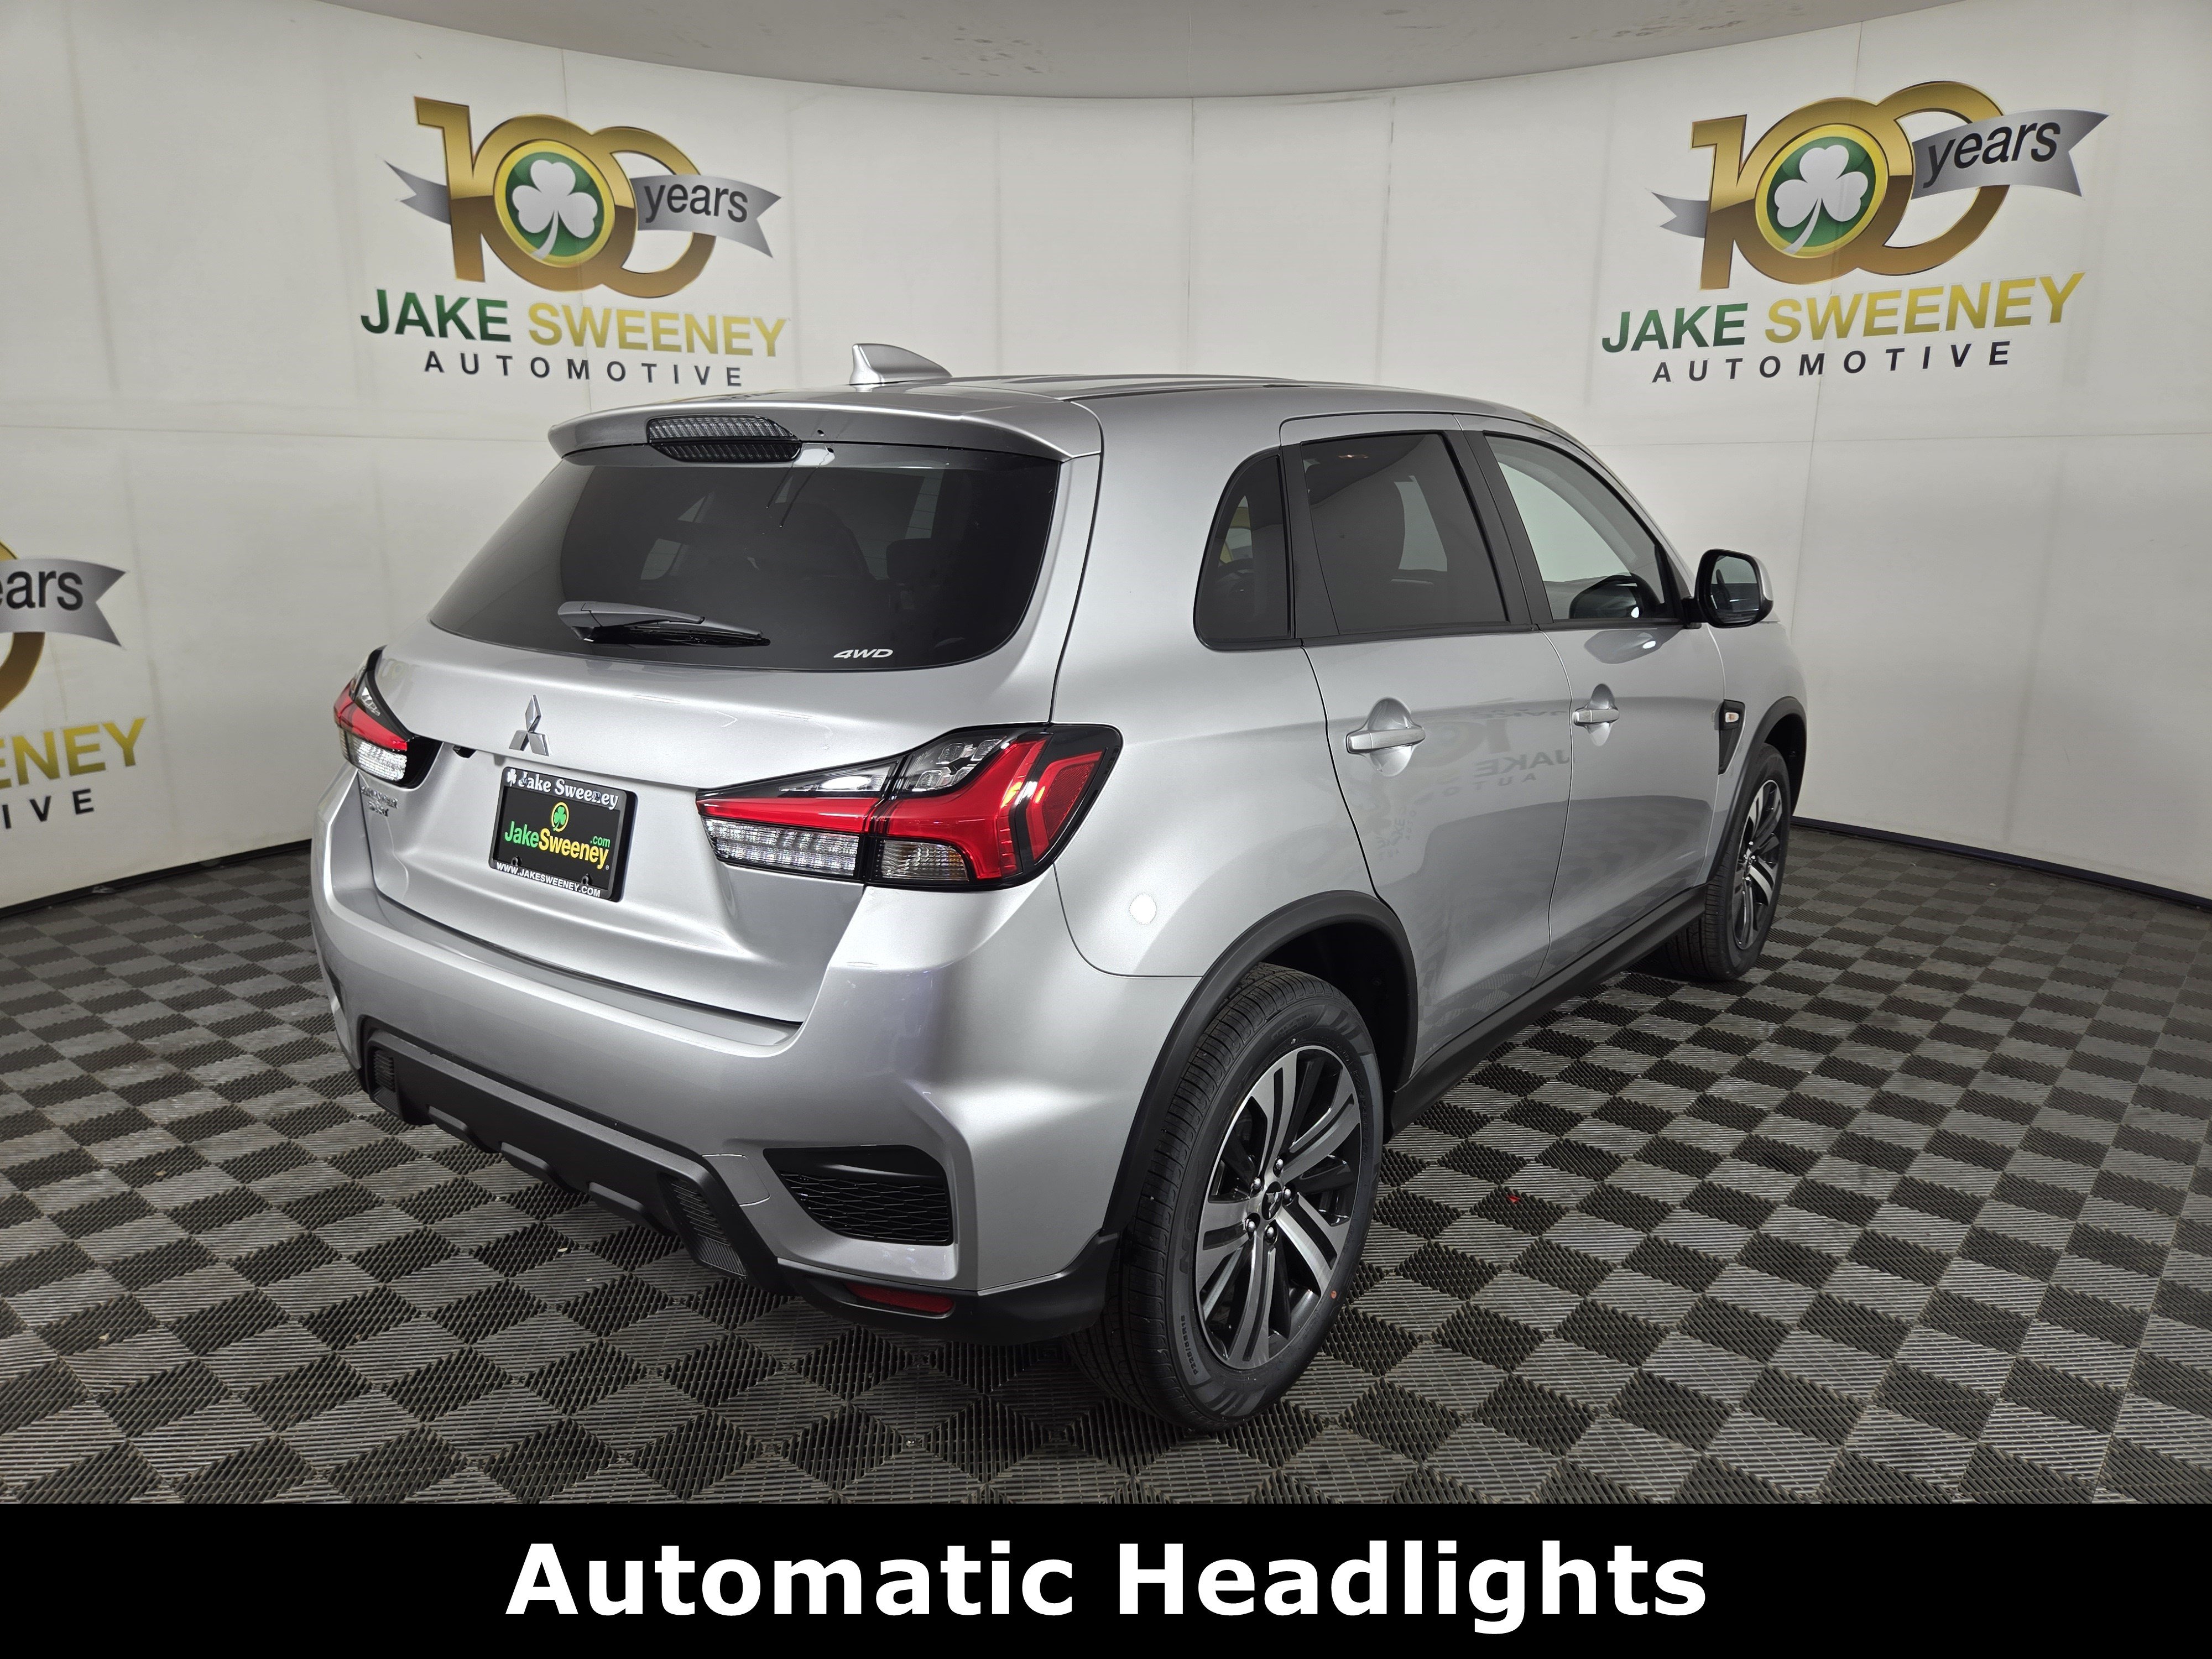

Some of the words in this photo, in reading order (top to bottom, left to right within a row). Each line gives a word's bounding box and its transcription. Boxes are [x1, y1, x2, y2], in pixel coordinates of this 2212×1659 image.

[1923, 120, 2060, 189] years
[644, 183, 749, 223] years
[361, 289, 512, 342] JAKE
[528, 302, 787, 357] SWEENEY
[1602, 302, 1748, 353] JAKE
[1765, 272, 2085, 343] SWEENEY
[424, 351, 742, 387] AUTOMOTIVE
[1652, 341, 2010, 383] AUTOMOTIVE
[0, 570, 83, 611] ars
[833, 649, 894, 659] 4WD
[518, 771, 551, 792] Jake
[555, 779, 619, 810] Sweeney
[505, 821, 609, 869] JakeSweeney
[589, 836, 611, 848] .com
[497, 862, 601, 897] WWW.JAKESWEENEY.COM
